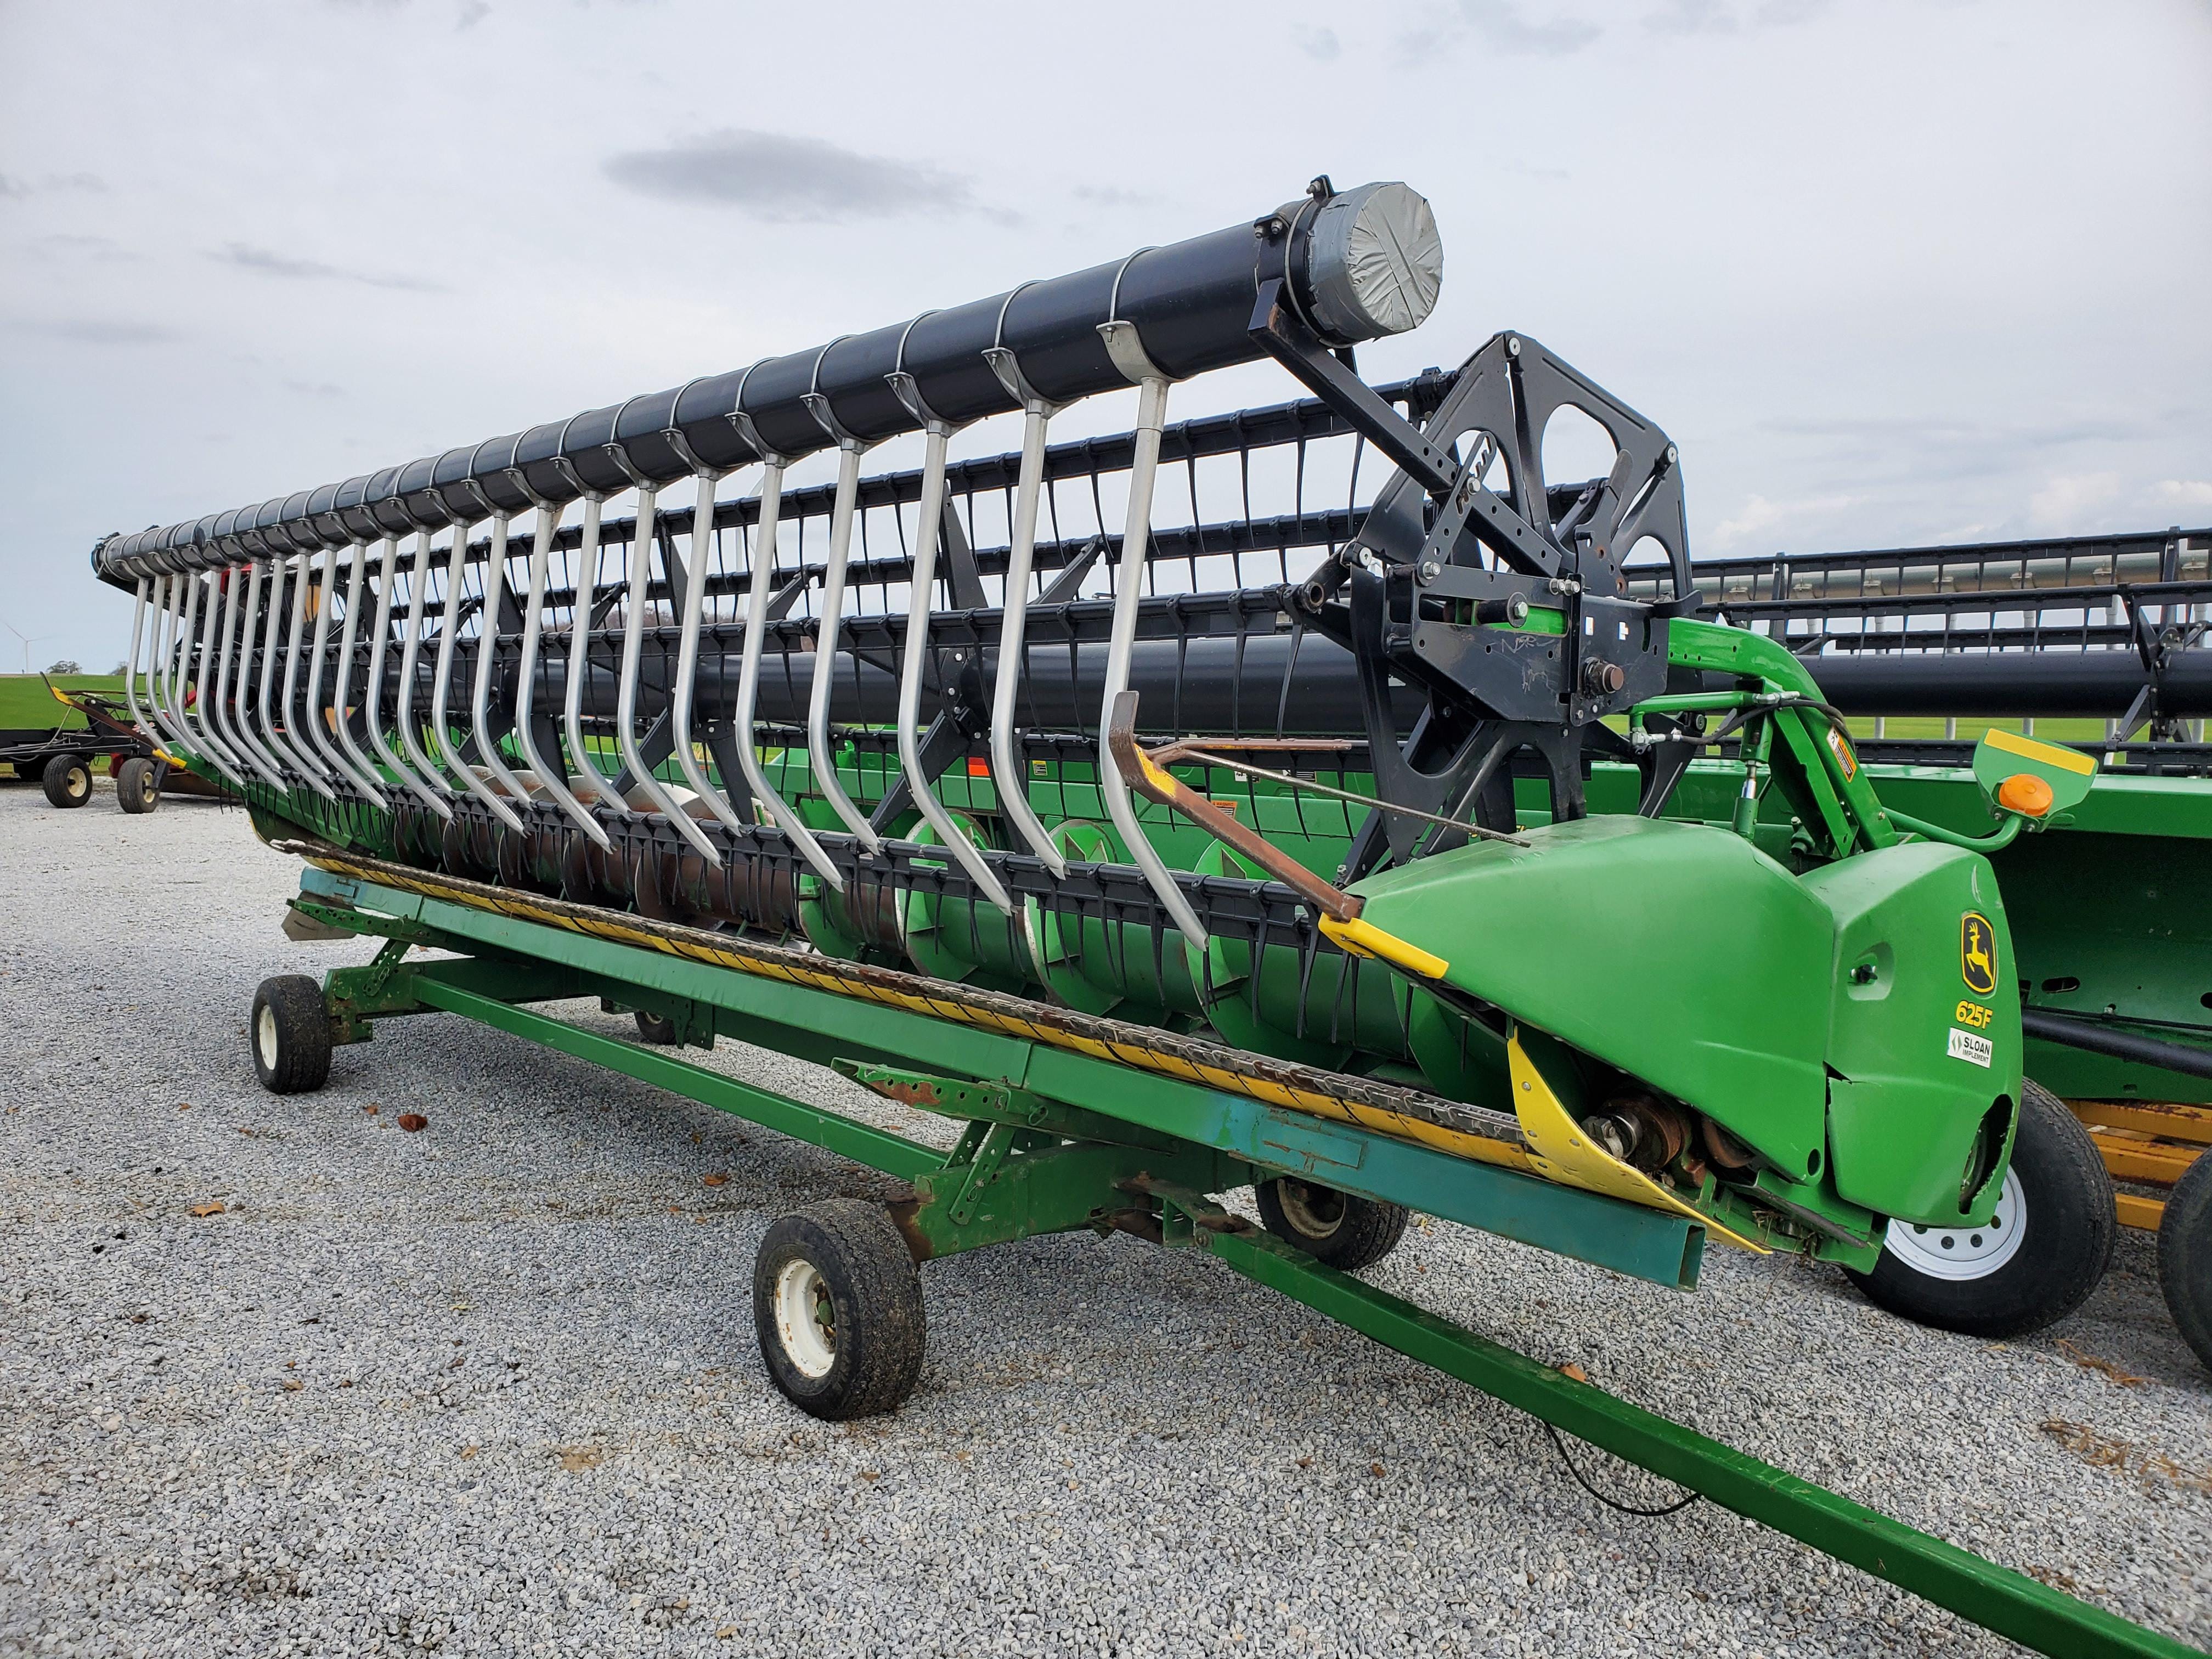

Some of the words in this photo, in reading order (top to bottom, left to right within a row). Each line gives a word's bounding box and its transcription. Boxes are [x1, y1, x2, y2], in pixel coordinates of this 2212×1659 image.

[1956, 1000, 1993, 1030] 625F
[1962, 1048, 1989, 1063] IMPLEMENT
[1963, 1037, 1990, 1056] SLOAN
